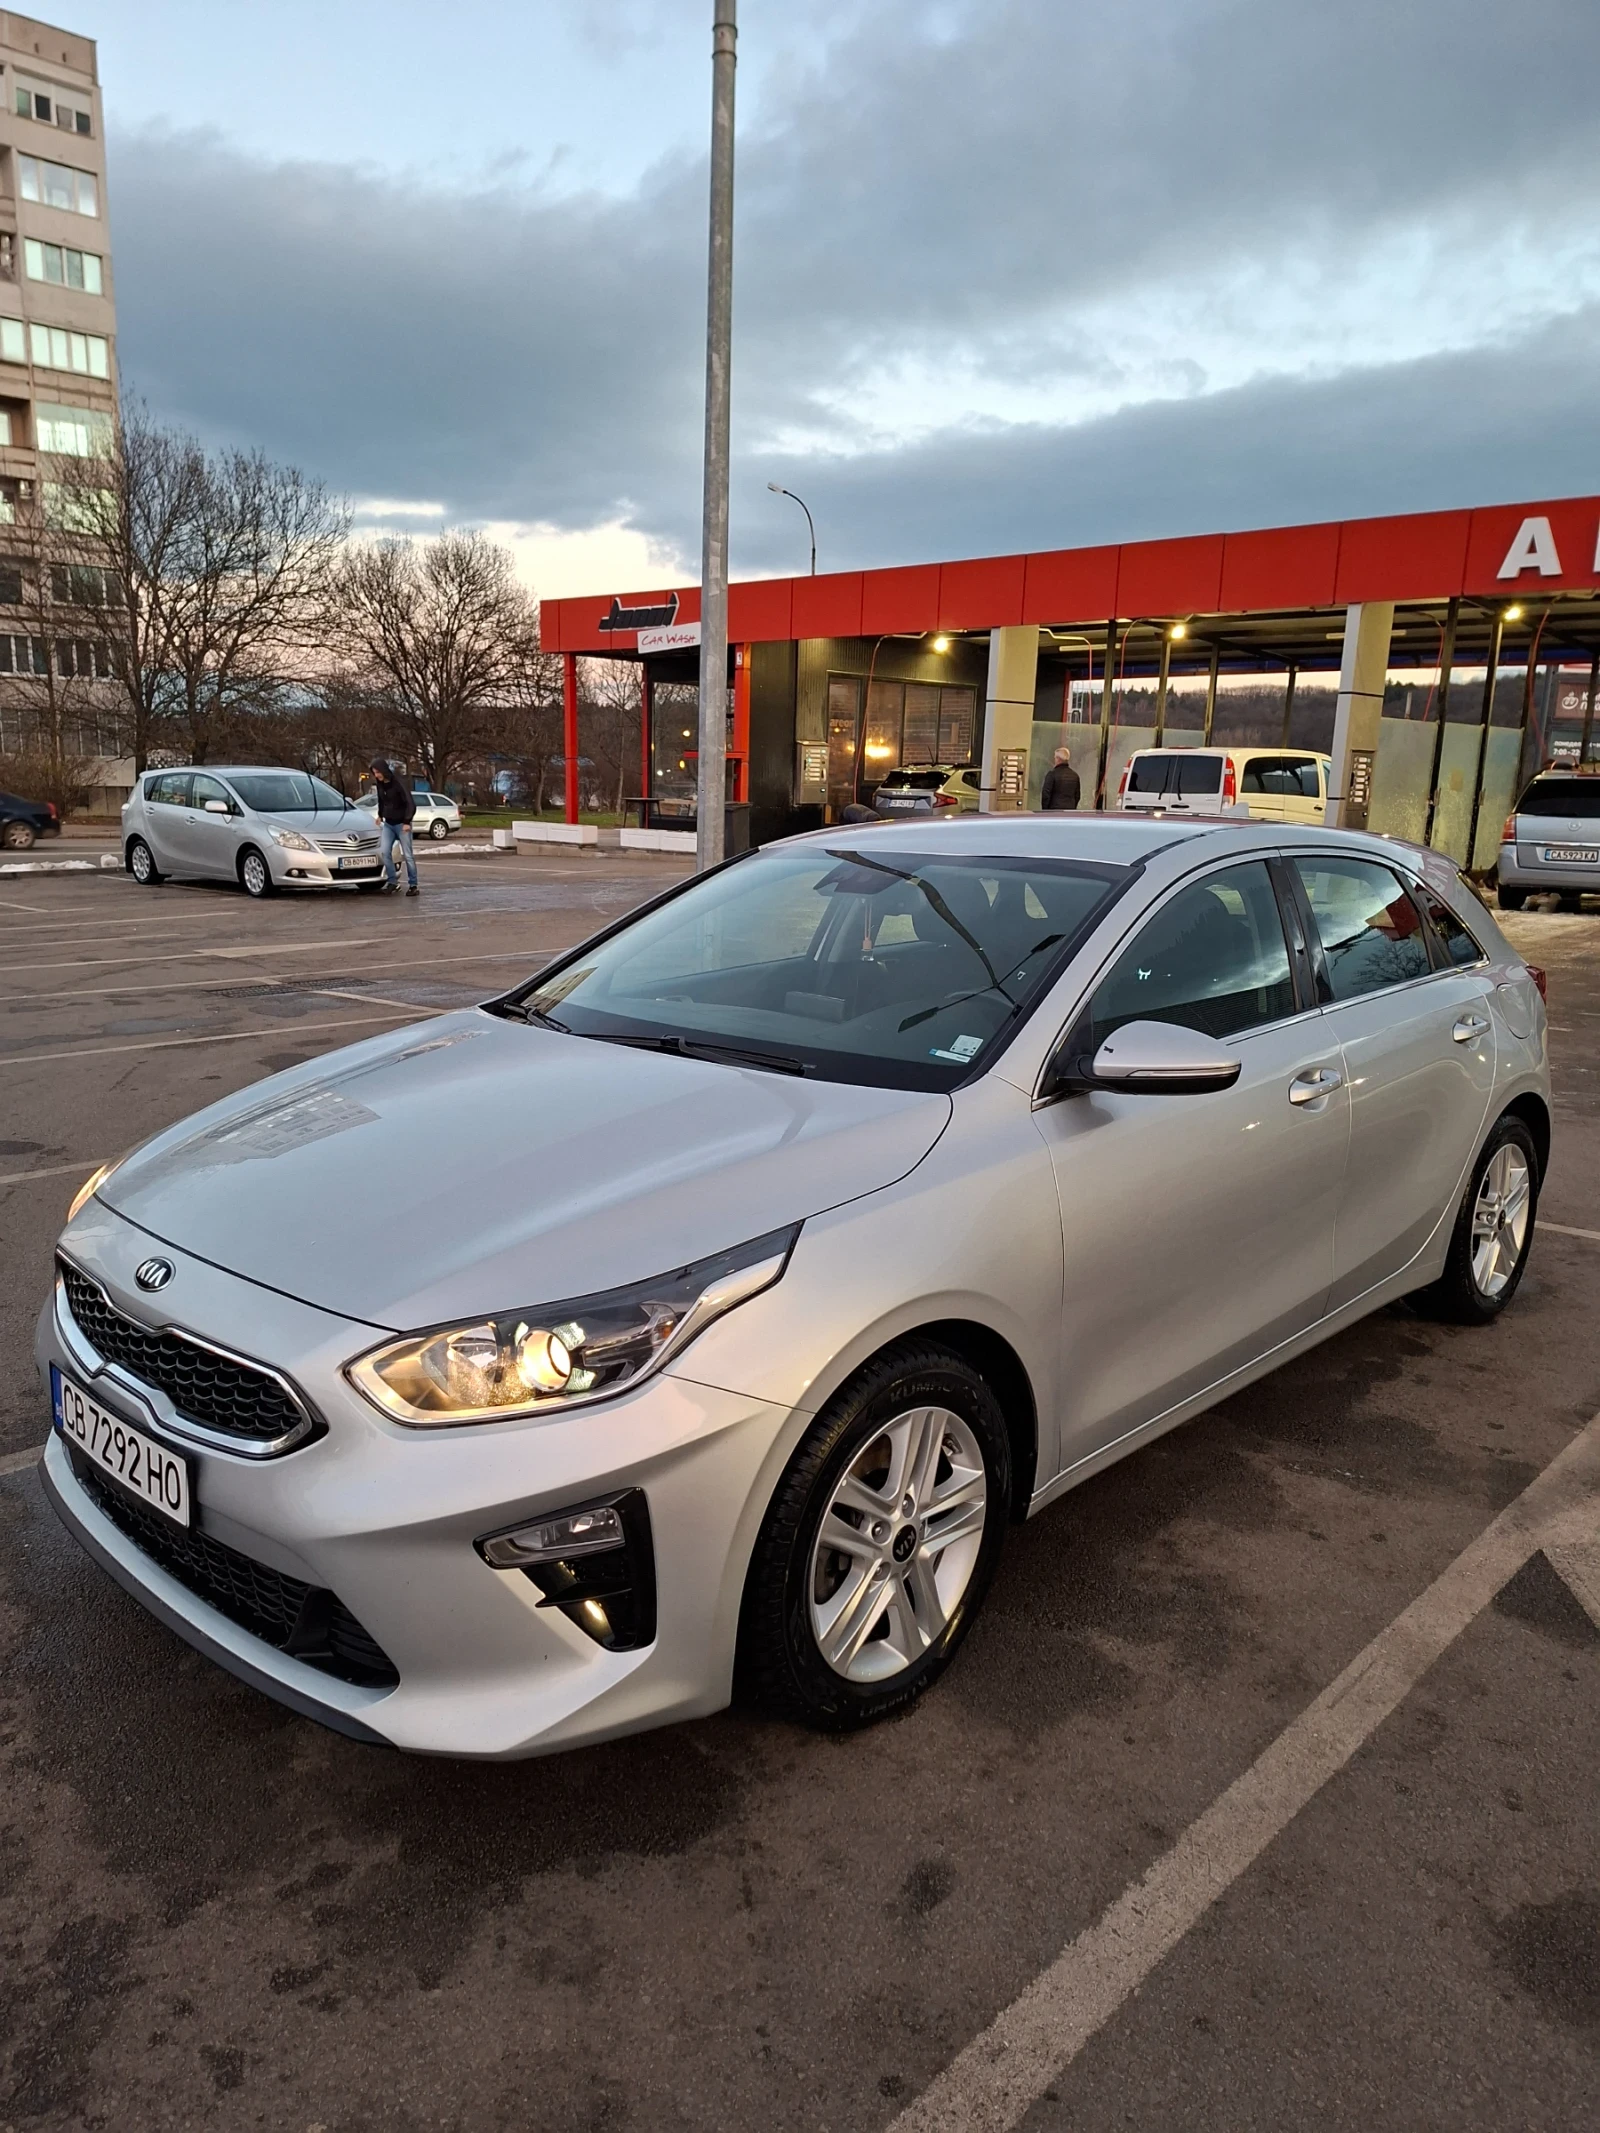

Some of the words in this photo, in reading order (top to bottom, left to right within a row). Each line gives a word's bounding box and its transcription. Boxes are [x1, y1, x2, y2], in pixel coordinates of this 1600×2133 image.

[641, 635, 664, 646] CAR
[666, 633, 696, 644] WASH
[136, 1260, 168, 1287] KIA
